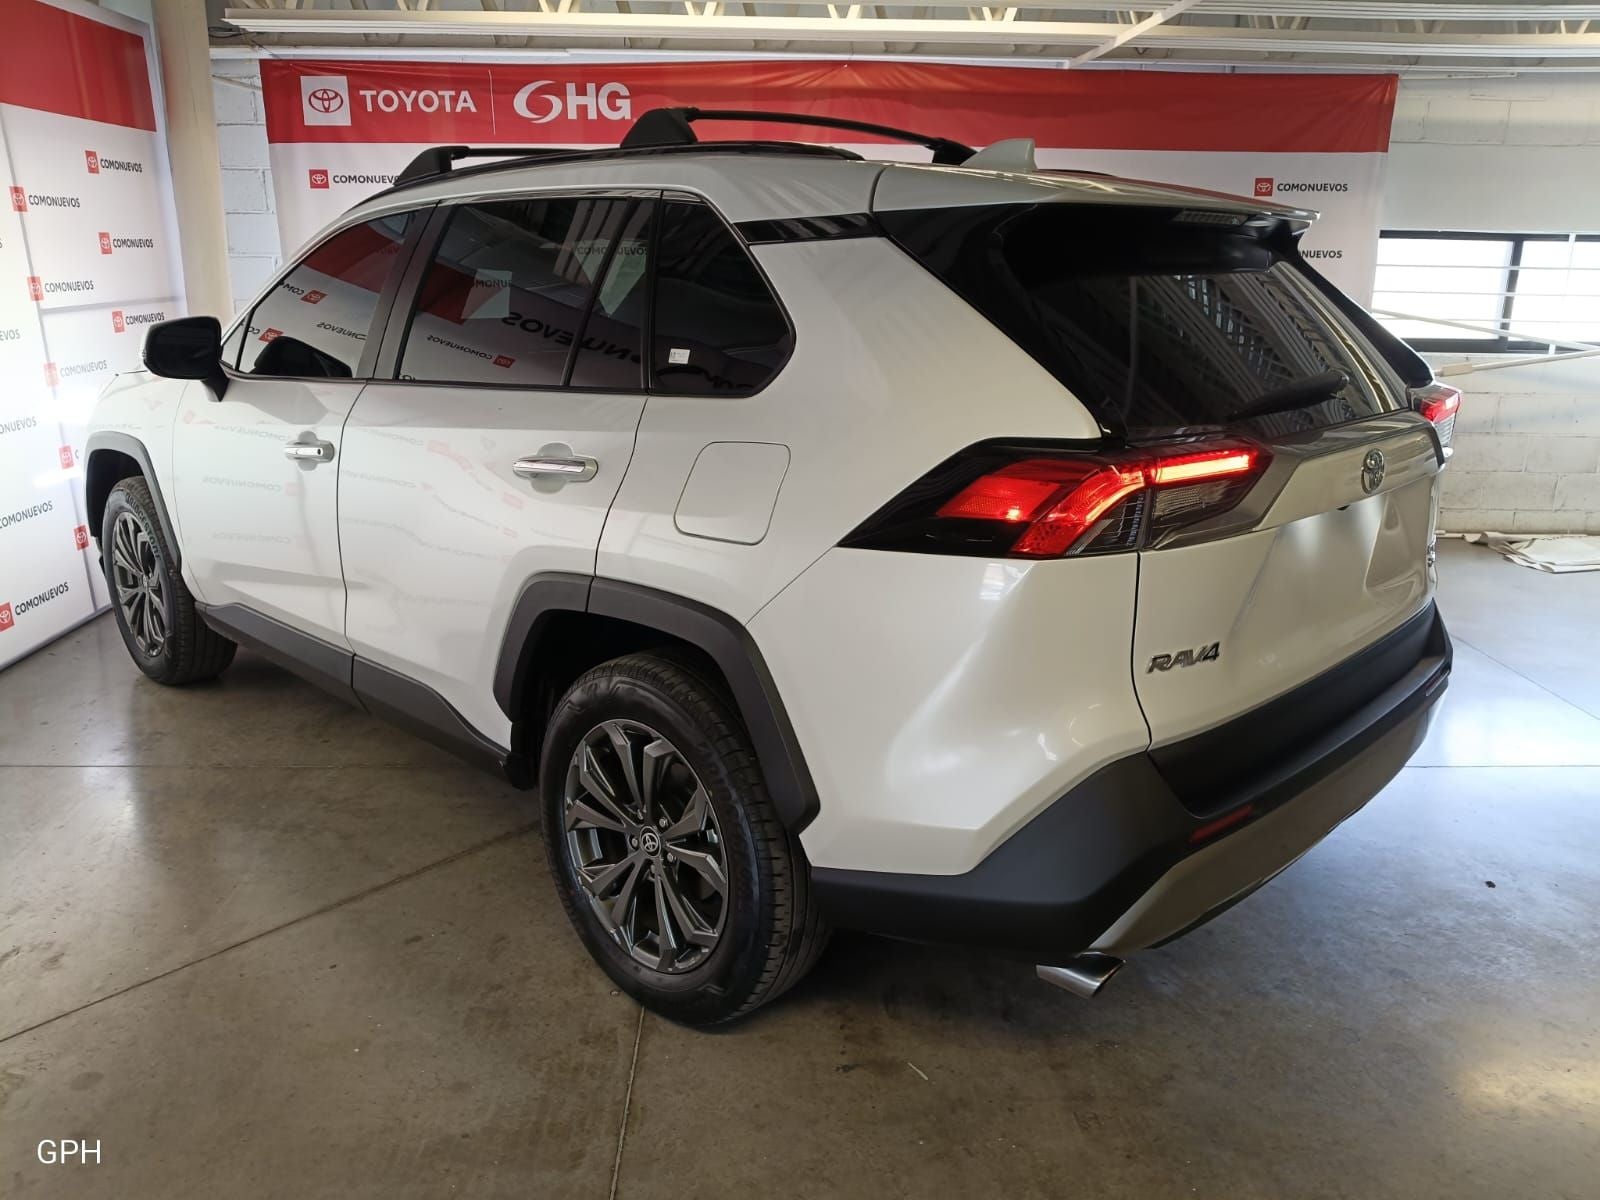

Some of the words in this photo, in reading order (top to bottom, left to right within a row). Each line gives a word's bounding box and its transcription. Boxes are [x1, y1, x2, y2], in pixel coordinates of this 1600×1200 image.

[359, 89, 477, 114] TOYOTA
[100, 158, 142, 173] COMONUEVOS
[332, 175, 400, 184] COMONUEV
[1277, 183, 1349, 193] COMONUEVOS
[28, 194, 81, 208] COMONUEVOS
[112, 238, 154, 248] COMONUEVOS
[1301, 250, 1343, 259] NUEVOS
[44, 280, 94, 292] COMONUEVOS
[125, 311, 165, 325] COMONUEVOS
[60, 360, 108, 376] COMONUEVOS
[0, 416, 37, 434] ONUEVOS
[0, 500, 53, 529] OMONUEVOS
[15, 581, 69, 616] COMONUEVOS
[1146, 641, 1220, 674] RAV4
